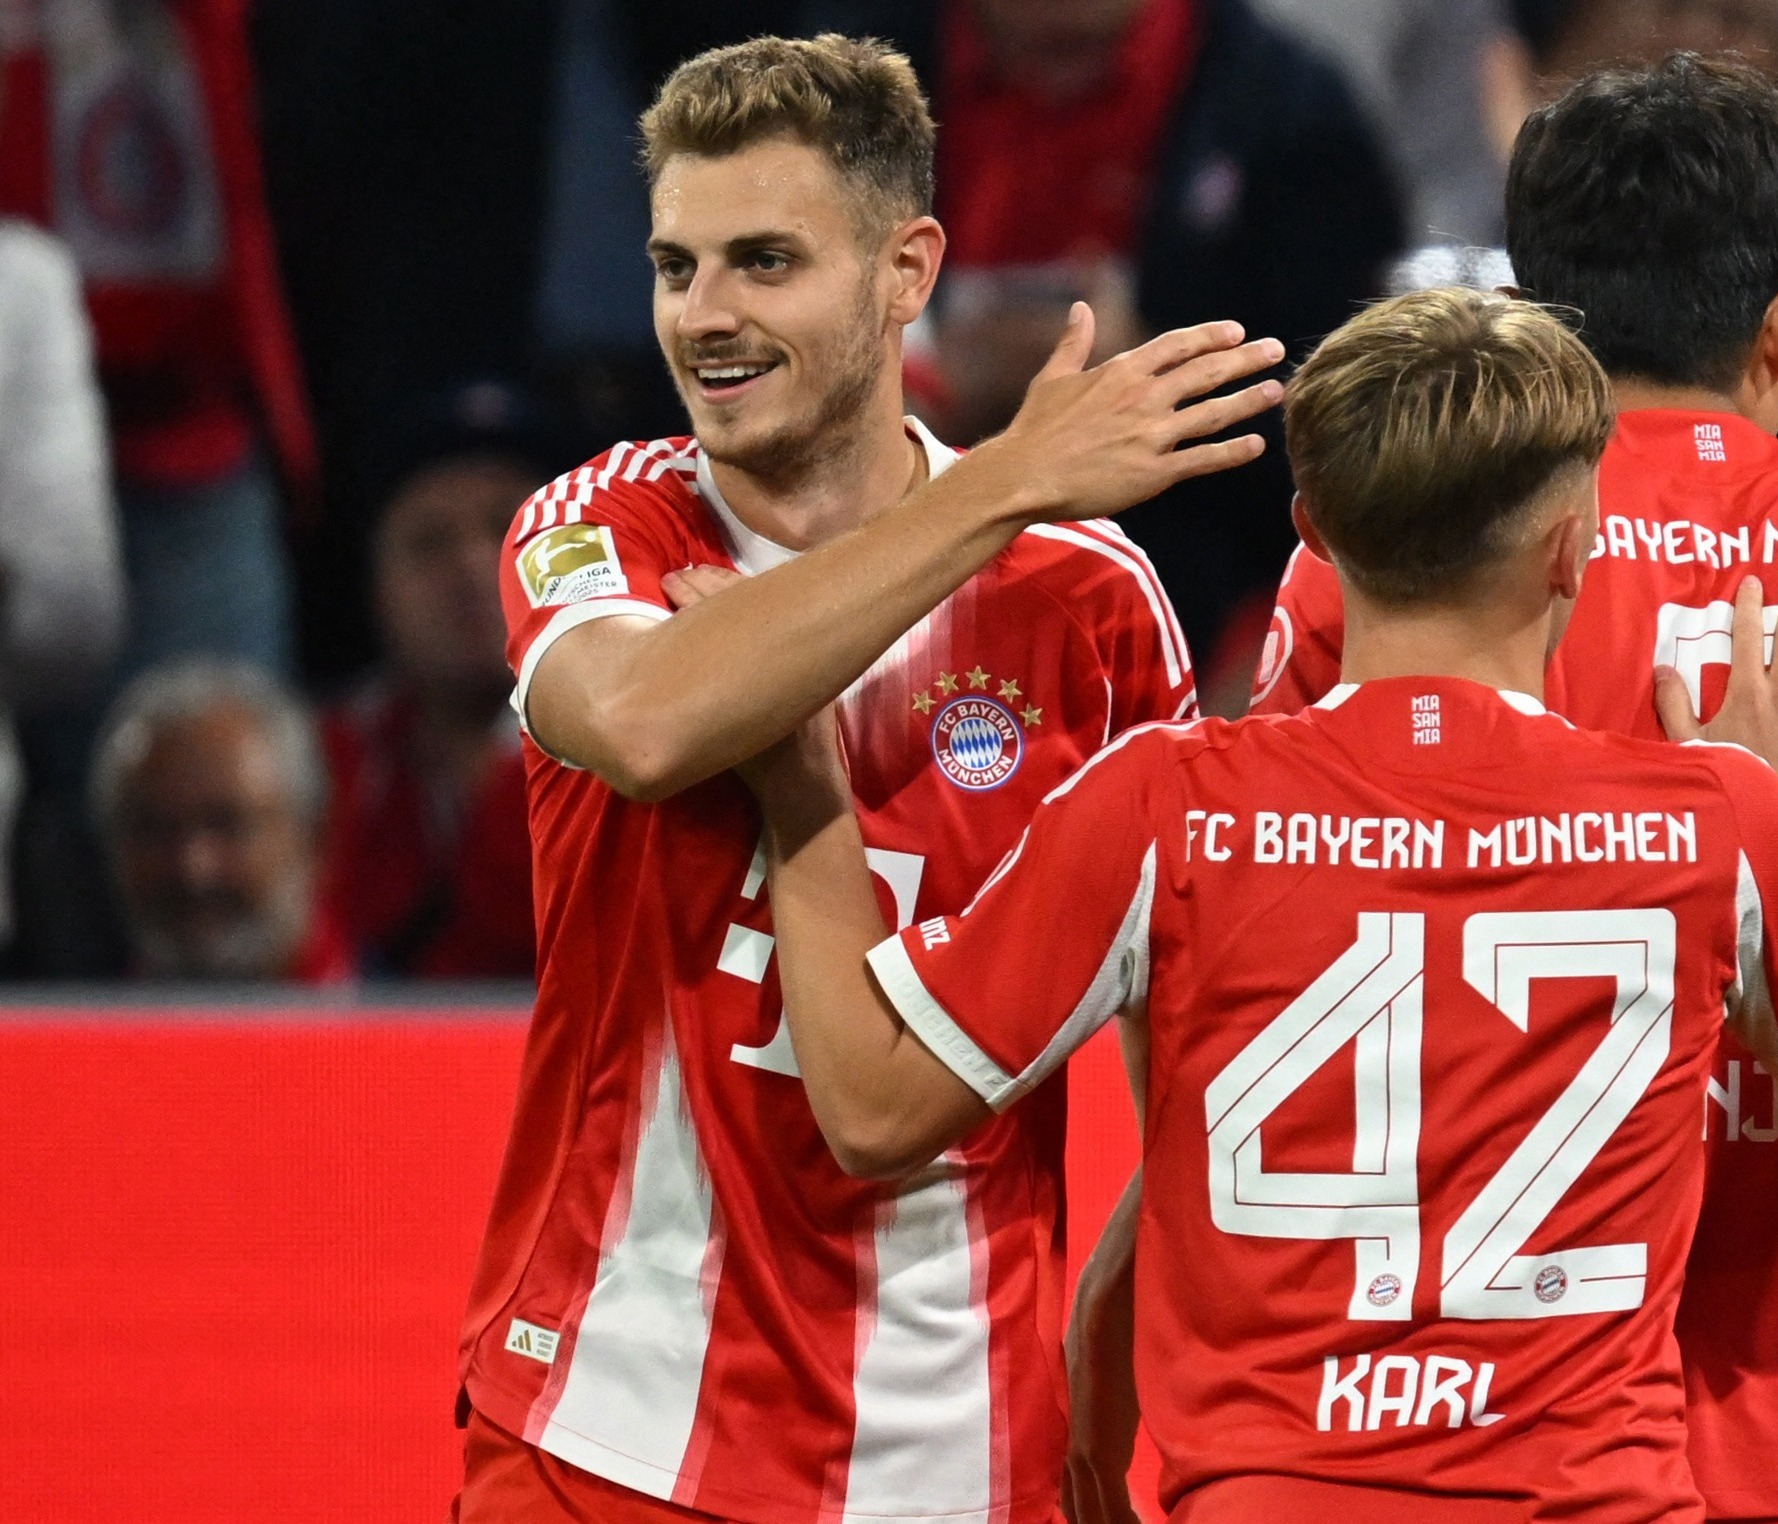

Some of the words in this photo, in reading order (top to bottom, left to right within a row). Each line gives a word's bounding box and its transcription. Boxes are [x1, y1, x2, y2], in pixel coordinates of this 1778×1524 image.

[1694, 424, 1721, 439] MIA
[1695, 440, 1723, 450] SAN
[1698, 451, 1726, 461] MIA
[1411, 695, 1440, 711] MIA
[939, 713, 957, 733] FC
[957, 703, 1015, 741] BAYERN
[1412, 712, 1440, 728] SAN
[1413, 728, 1441, 745] MIA
[1184, 811, 1235, 863] FC
[1254, 811, 1444, 869] BAYERN
[1467, 812, 1698, 868] MÜNCHEN
[1204, 907, 1677, 1321] 42
[1317, 1353, 1507, 1432] KARL
